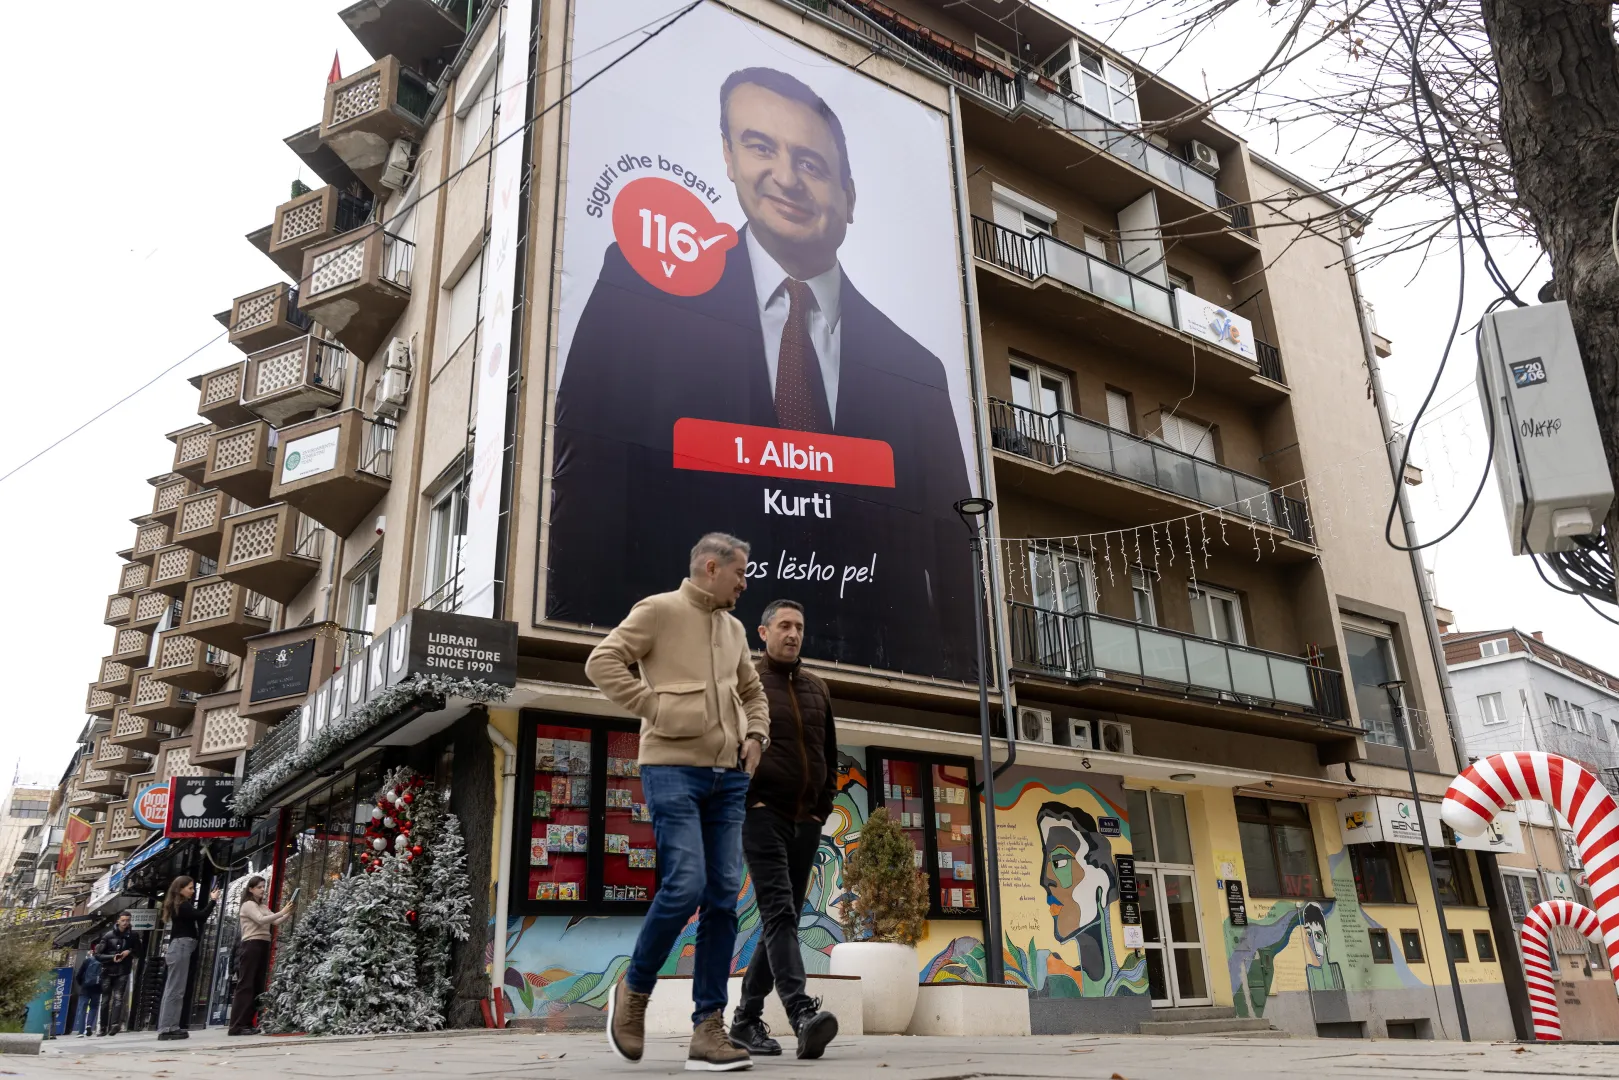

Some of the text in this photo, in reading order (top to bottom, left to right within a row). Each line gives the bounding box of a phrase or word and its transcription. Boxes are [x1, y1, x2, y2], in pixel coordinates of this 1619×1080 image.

[586, 153, 722, 219] Siguri dhe begati
[638, 207, 699, 263] 116
[1525, 361, 1542, 373] 20
[1529, 371, 1545, 382] 06
[734, 436, 834, 473] 1. Albin
[763, 488, 832, 519] Kurti
[744, 549, 877, 599] os lësho pe!
[428, 632, 478, 646] LIBRARI
[427, 644, 501, 662] BOOKSTORE
[426, 656, 494, 674] SINCE 1990
[300, 623, 408, 745] BUZUKU
[186, 779, 235, 787] APPLE SAMS
[143, 793, 169, 808] prop
[145, 805, 168, 820] pizz
[178, 817, 226, 829] MOBISHOP
